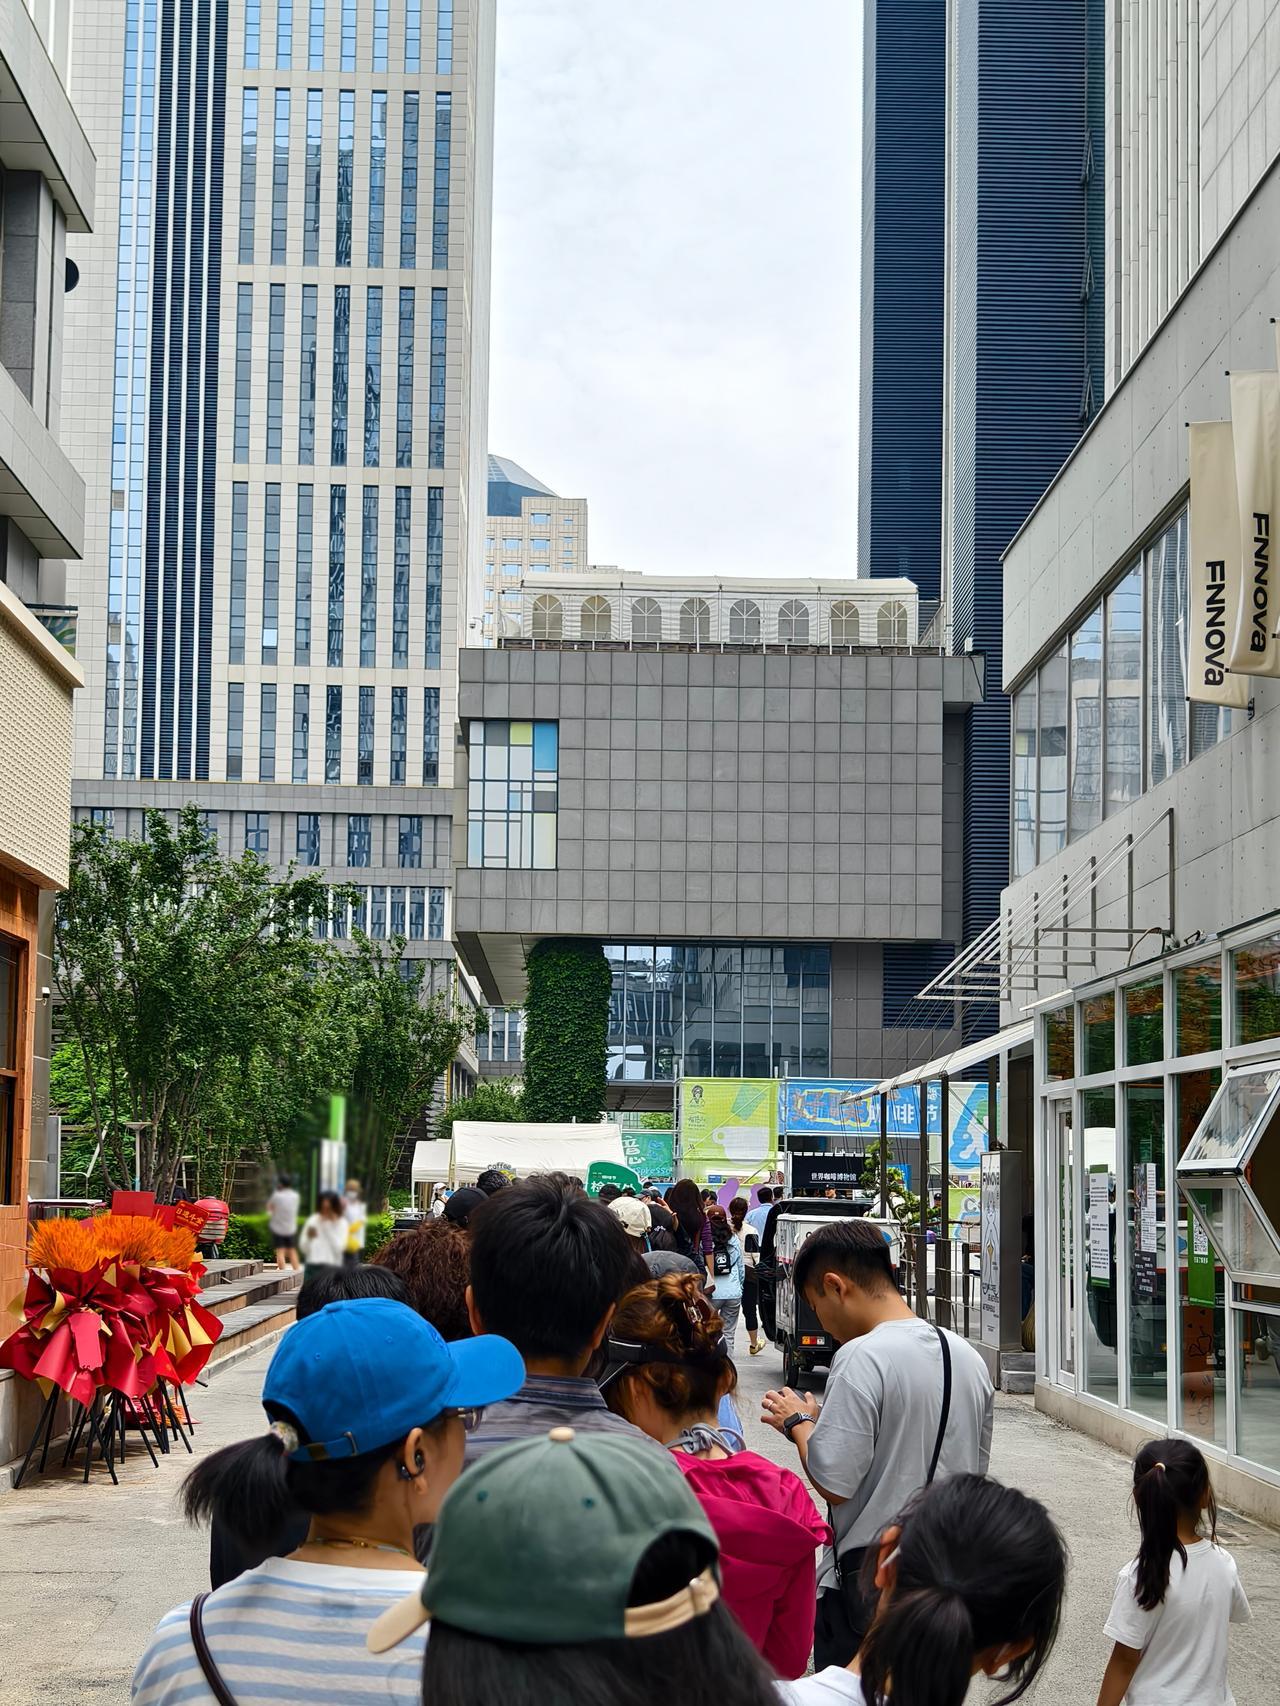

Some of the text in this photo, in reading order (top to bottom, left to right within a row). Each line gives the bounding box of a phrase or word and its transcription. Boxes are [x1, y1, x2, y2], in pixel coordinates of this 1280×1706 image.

[811, 1172, 857, 1182] 世界咖啡博物馆
